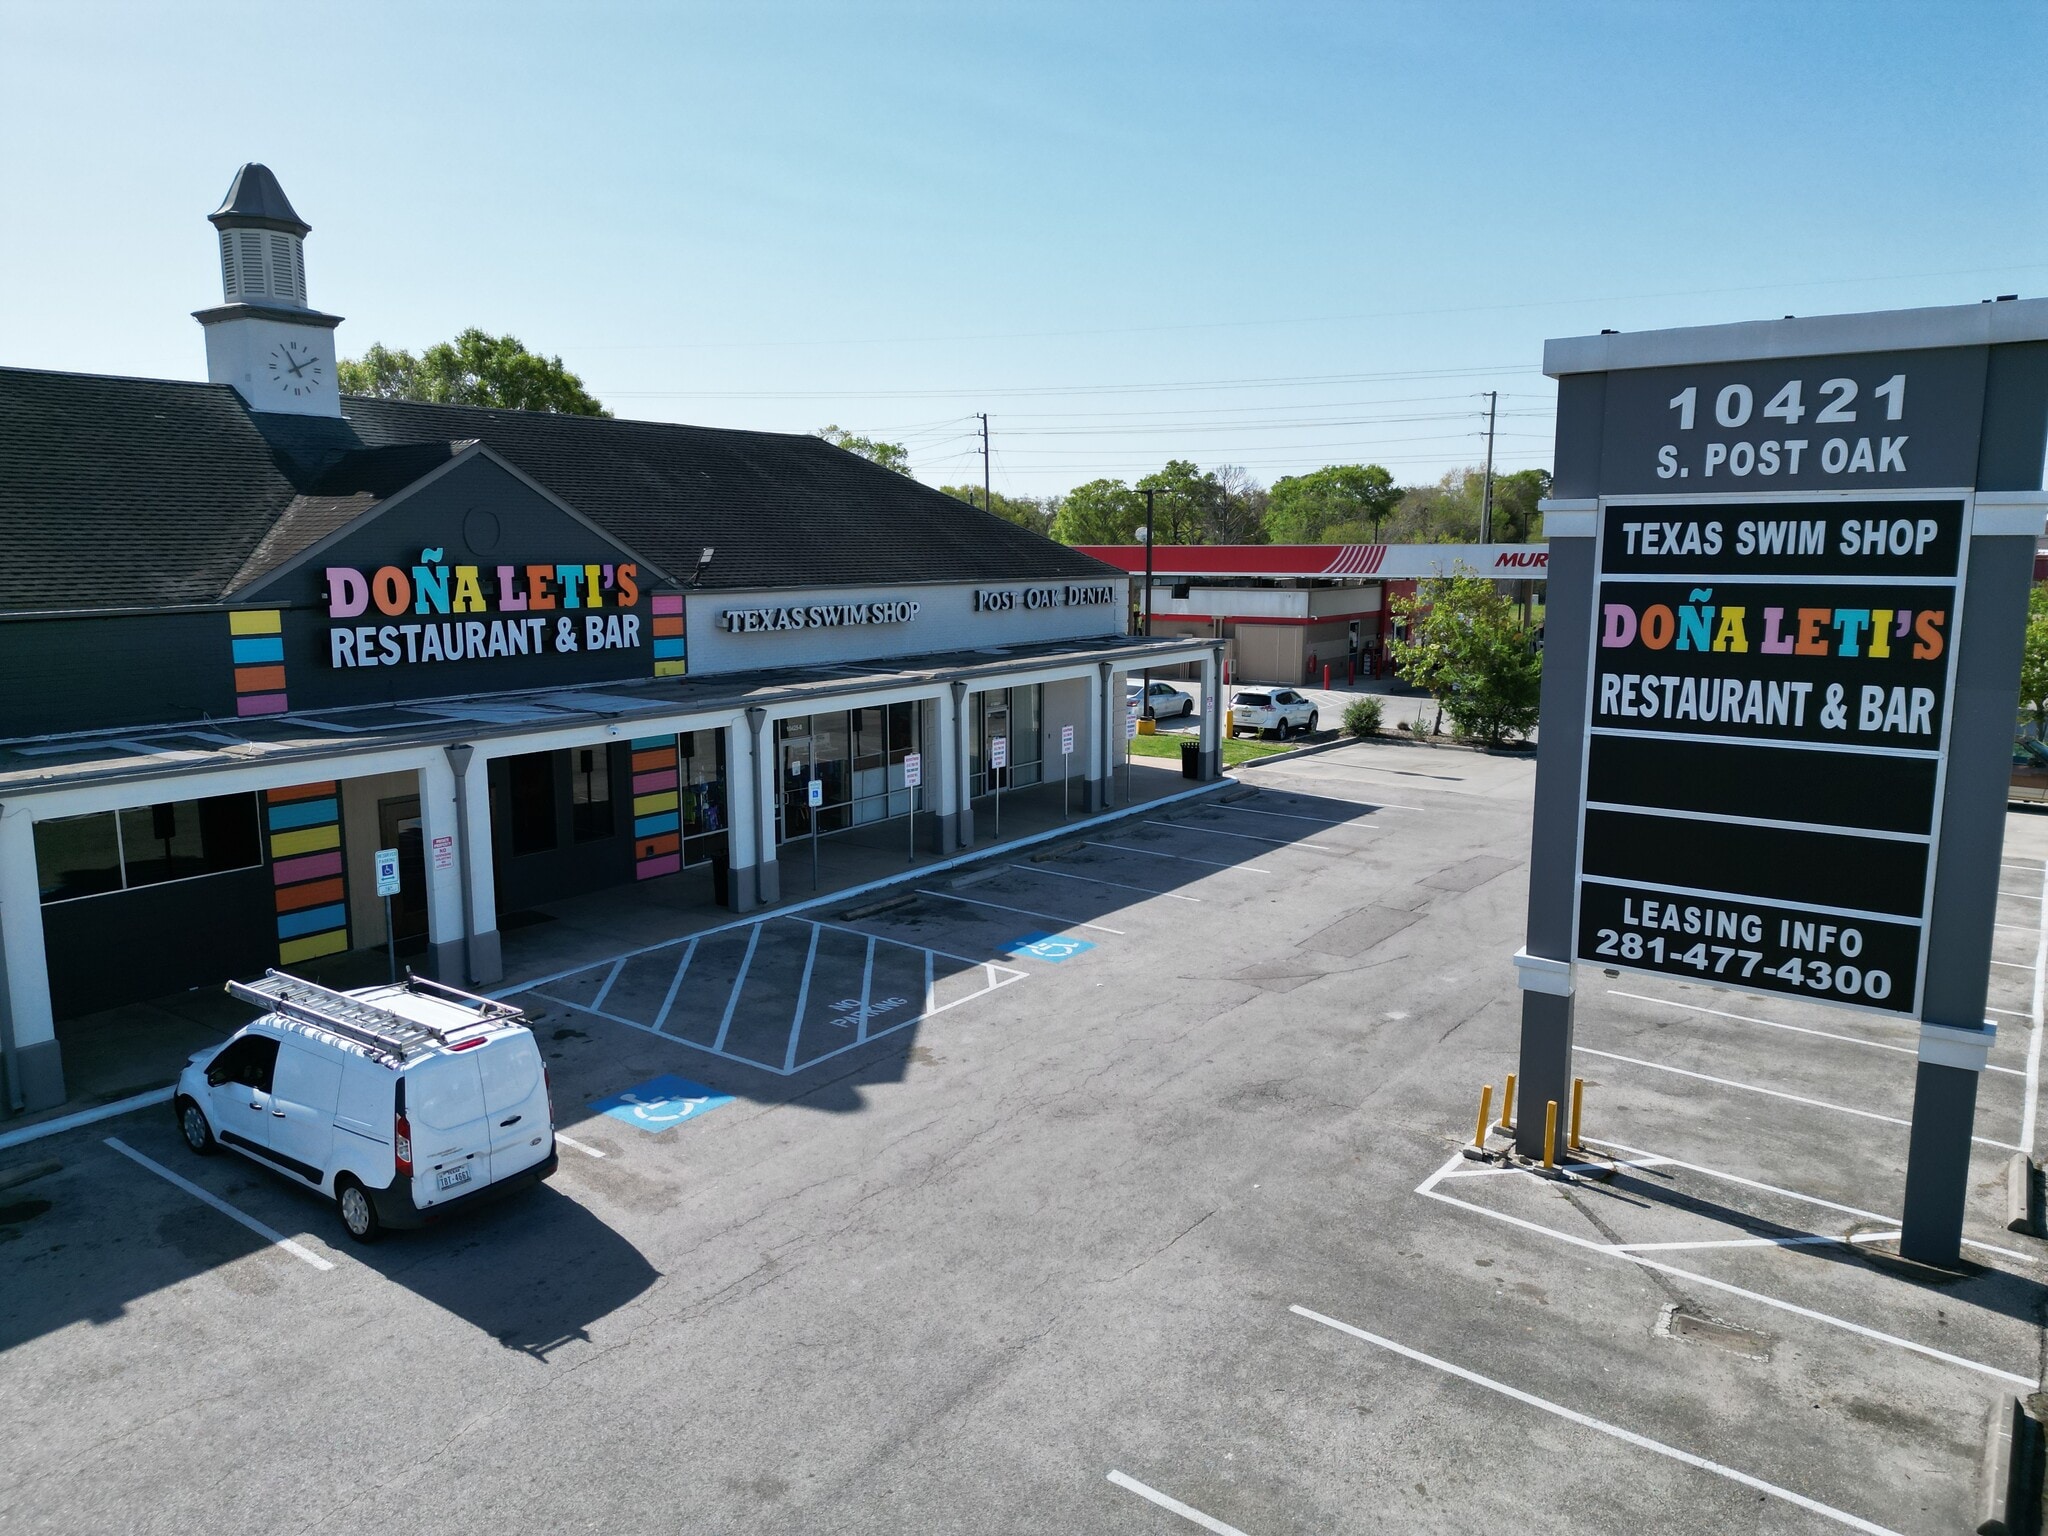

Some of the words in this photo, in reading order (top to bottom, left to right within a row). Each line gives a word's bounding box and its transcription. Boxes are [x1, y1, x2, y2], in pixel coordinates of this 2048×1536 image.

[1669, 374, 1906, 430] 10421
[1656, 444, 1689, 479] S.
[1704, 439, 1809, 478] POST
[1821, 435, 1910, 475] OAK
[1622, 520, 1724, 556] TEXAS
[1735, 519, 1827, 556] SWIM
[1839, 518, 1938, 556] SHOP
[326, 547, 487, 618] DOÑA
[496, 563, 640, 612] LETI'S
[330, 617, 546, 668] RESTAURANT
[555, 616, 578, 653] &
[585, 614, 640, 651] BAR
[726, 607, 805, 633] TEXAS
[808, 603, 868, 629] SWIM
[871, 601, 921, 625] SHOP
[1601, 587, 1750, 653] DOÑA
[1760, 606, 1945, 661] LETI'S
[1600, 672, 1814, 728] RESTAURANT
[1820, 682, 1848, 730] &
[1858, 684, 1936, 736] BAR
[1623, 897, 1763, 944] LEASING
[1779, 918, 1863, 959] INFO
[1594, 928, 1893, 1000] 281-477-4300
[828, 998, 861, 1012] NO
